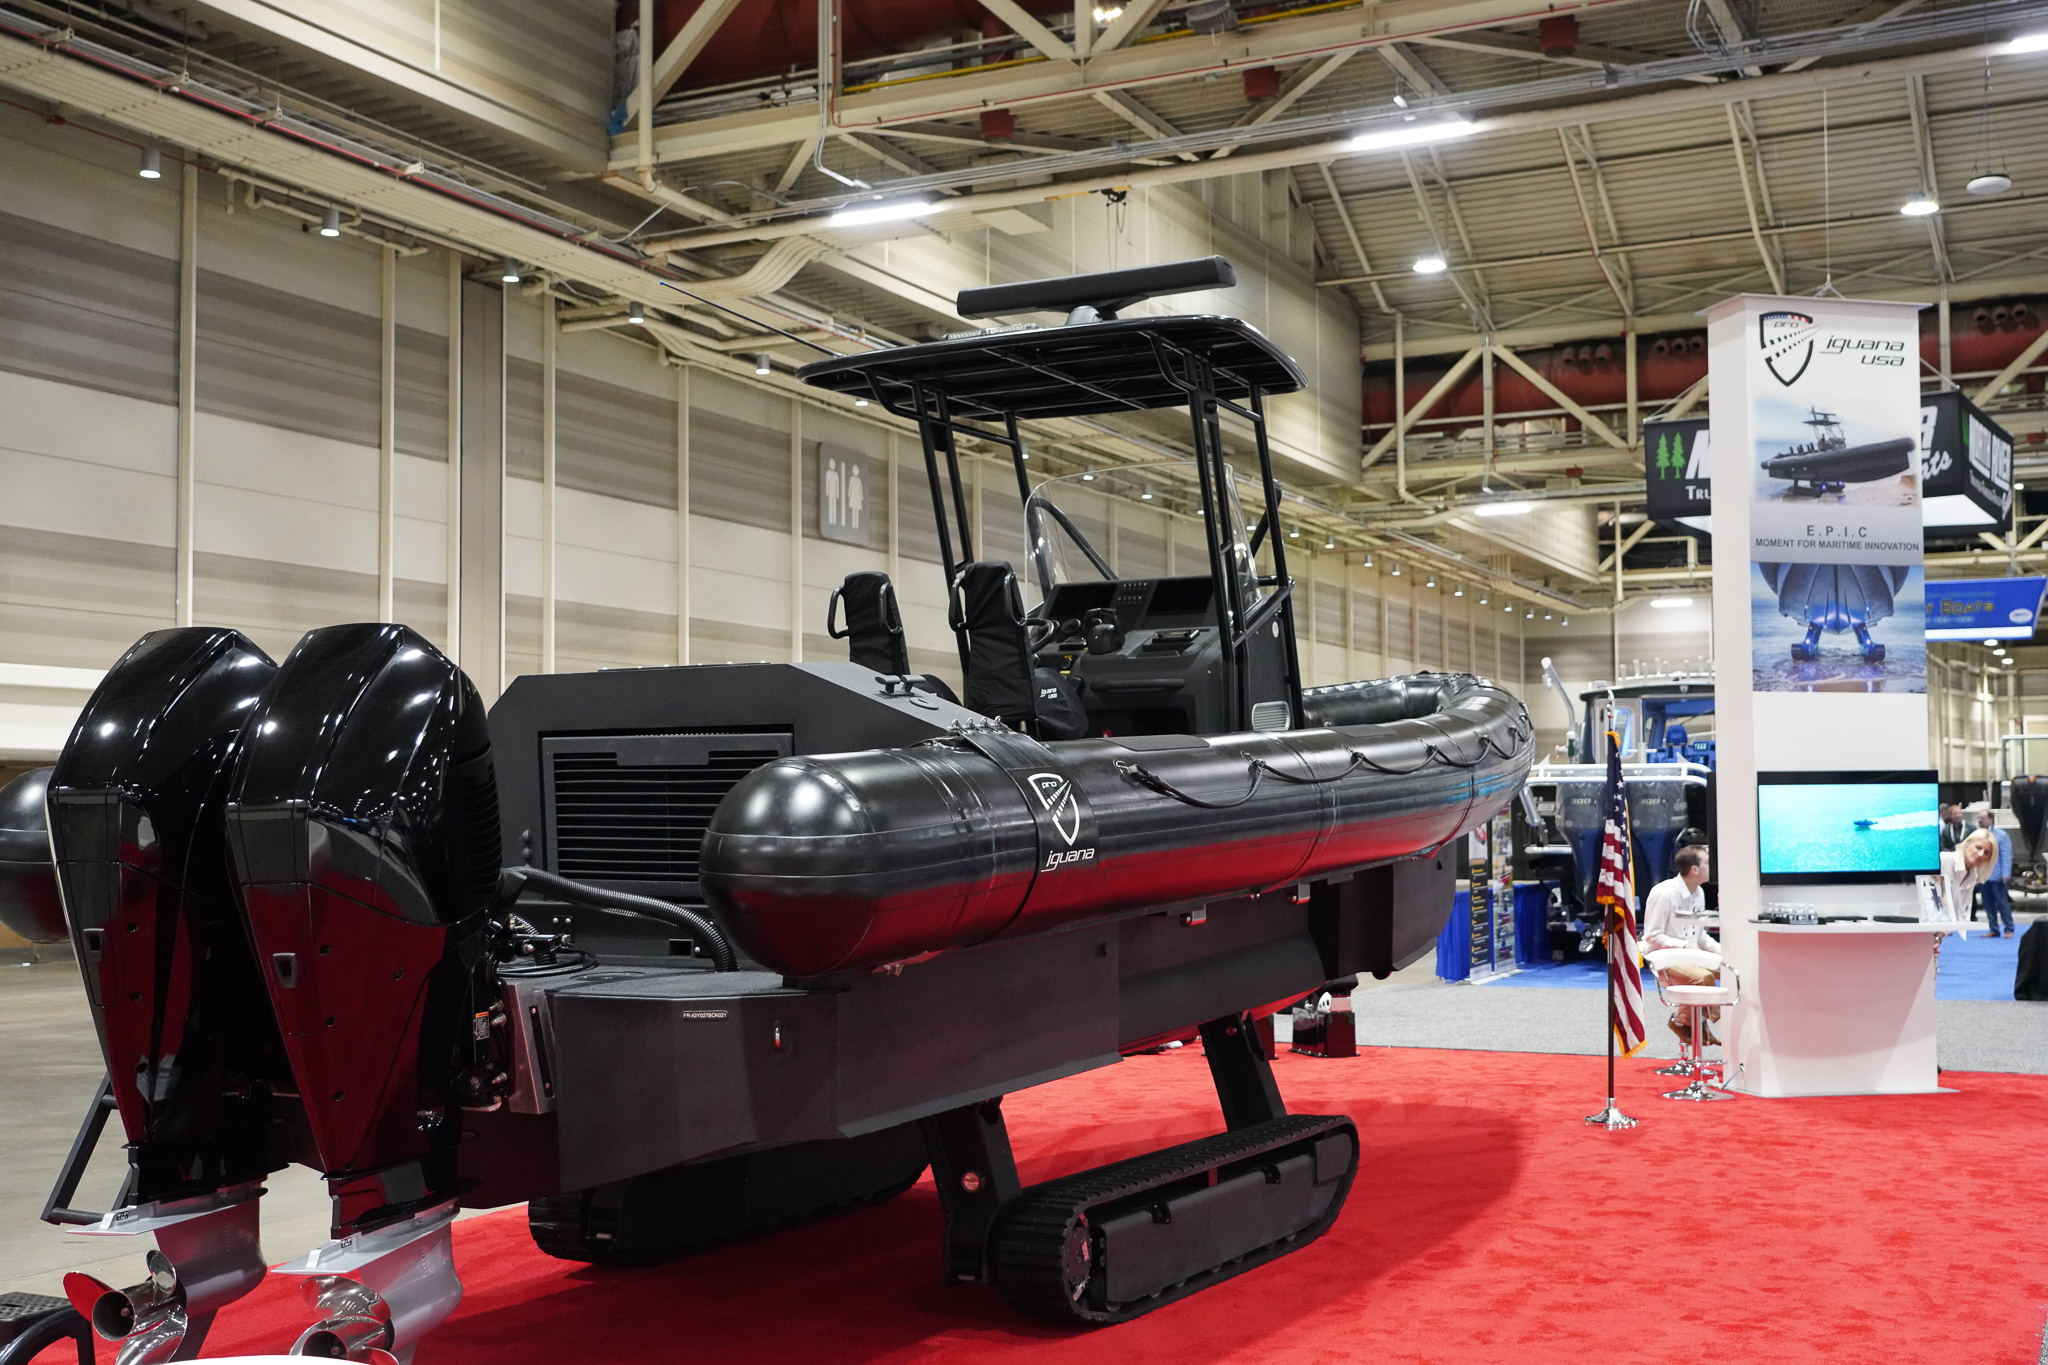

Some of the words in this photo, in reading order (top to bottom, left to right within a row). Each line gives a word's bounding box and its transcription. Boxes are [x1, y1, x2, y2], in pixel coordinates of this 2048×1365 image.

[1774, 320, 1799, 328] pro
[1819, 335, 1904, 354] iguana
[1861, 355, 1904, 366] usa
[1755, 538, 1794, 548] MOMENT
[1797, 539, 1816, 549] FOR
[1819, 540, 1862, 550] MARITIME
[1864, 541, 1919, 551] INNOVATION
[1042, 781, 1057, 789] pro
[1041, 848, 1095, 872] iguana
